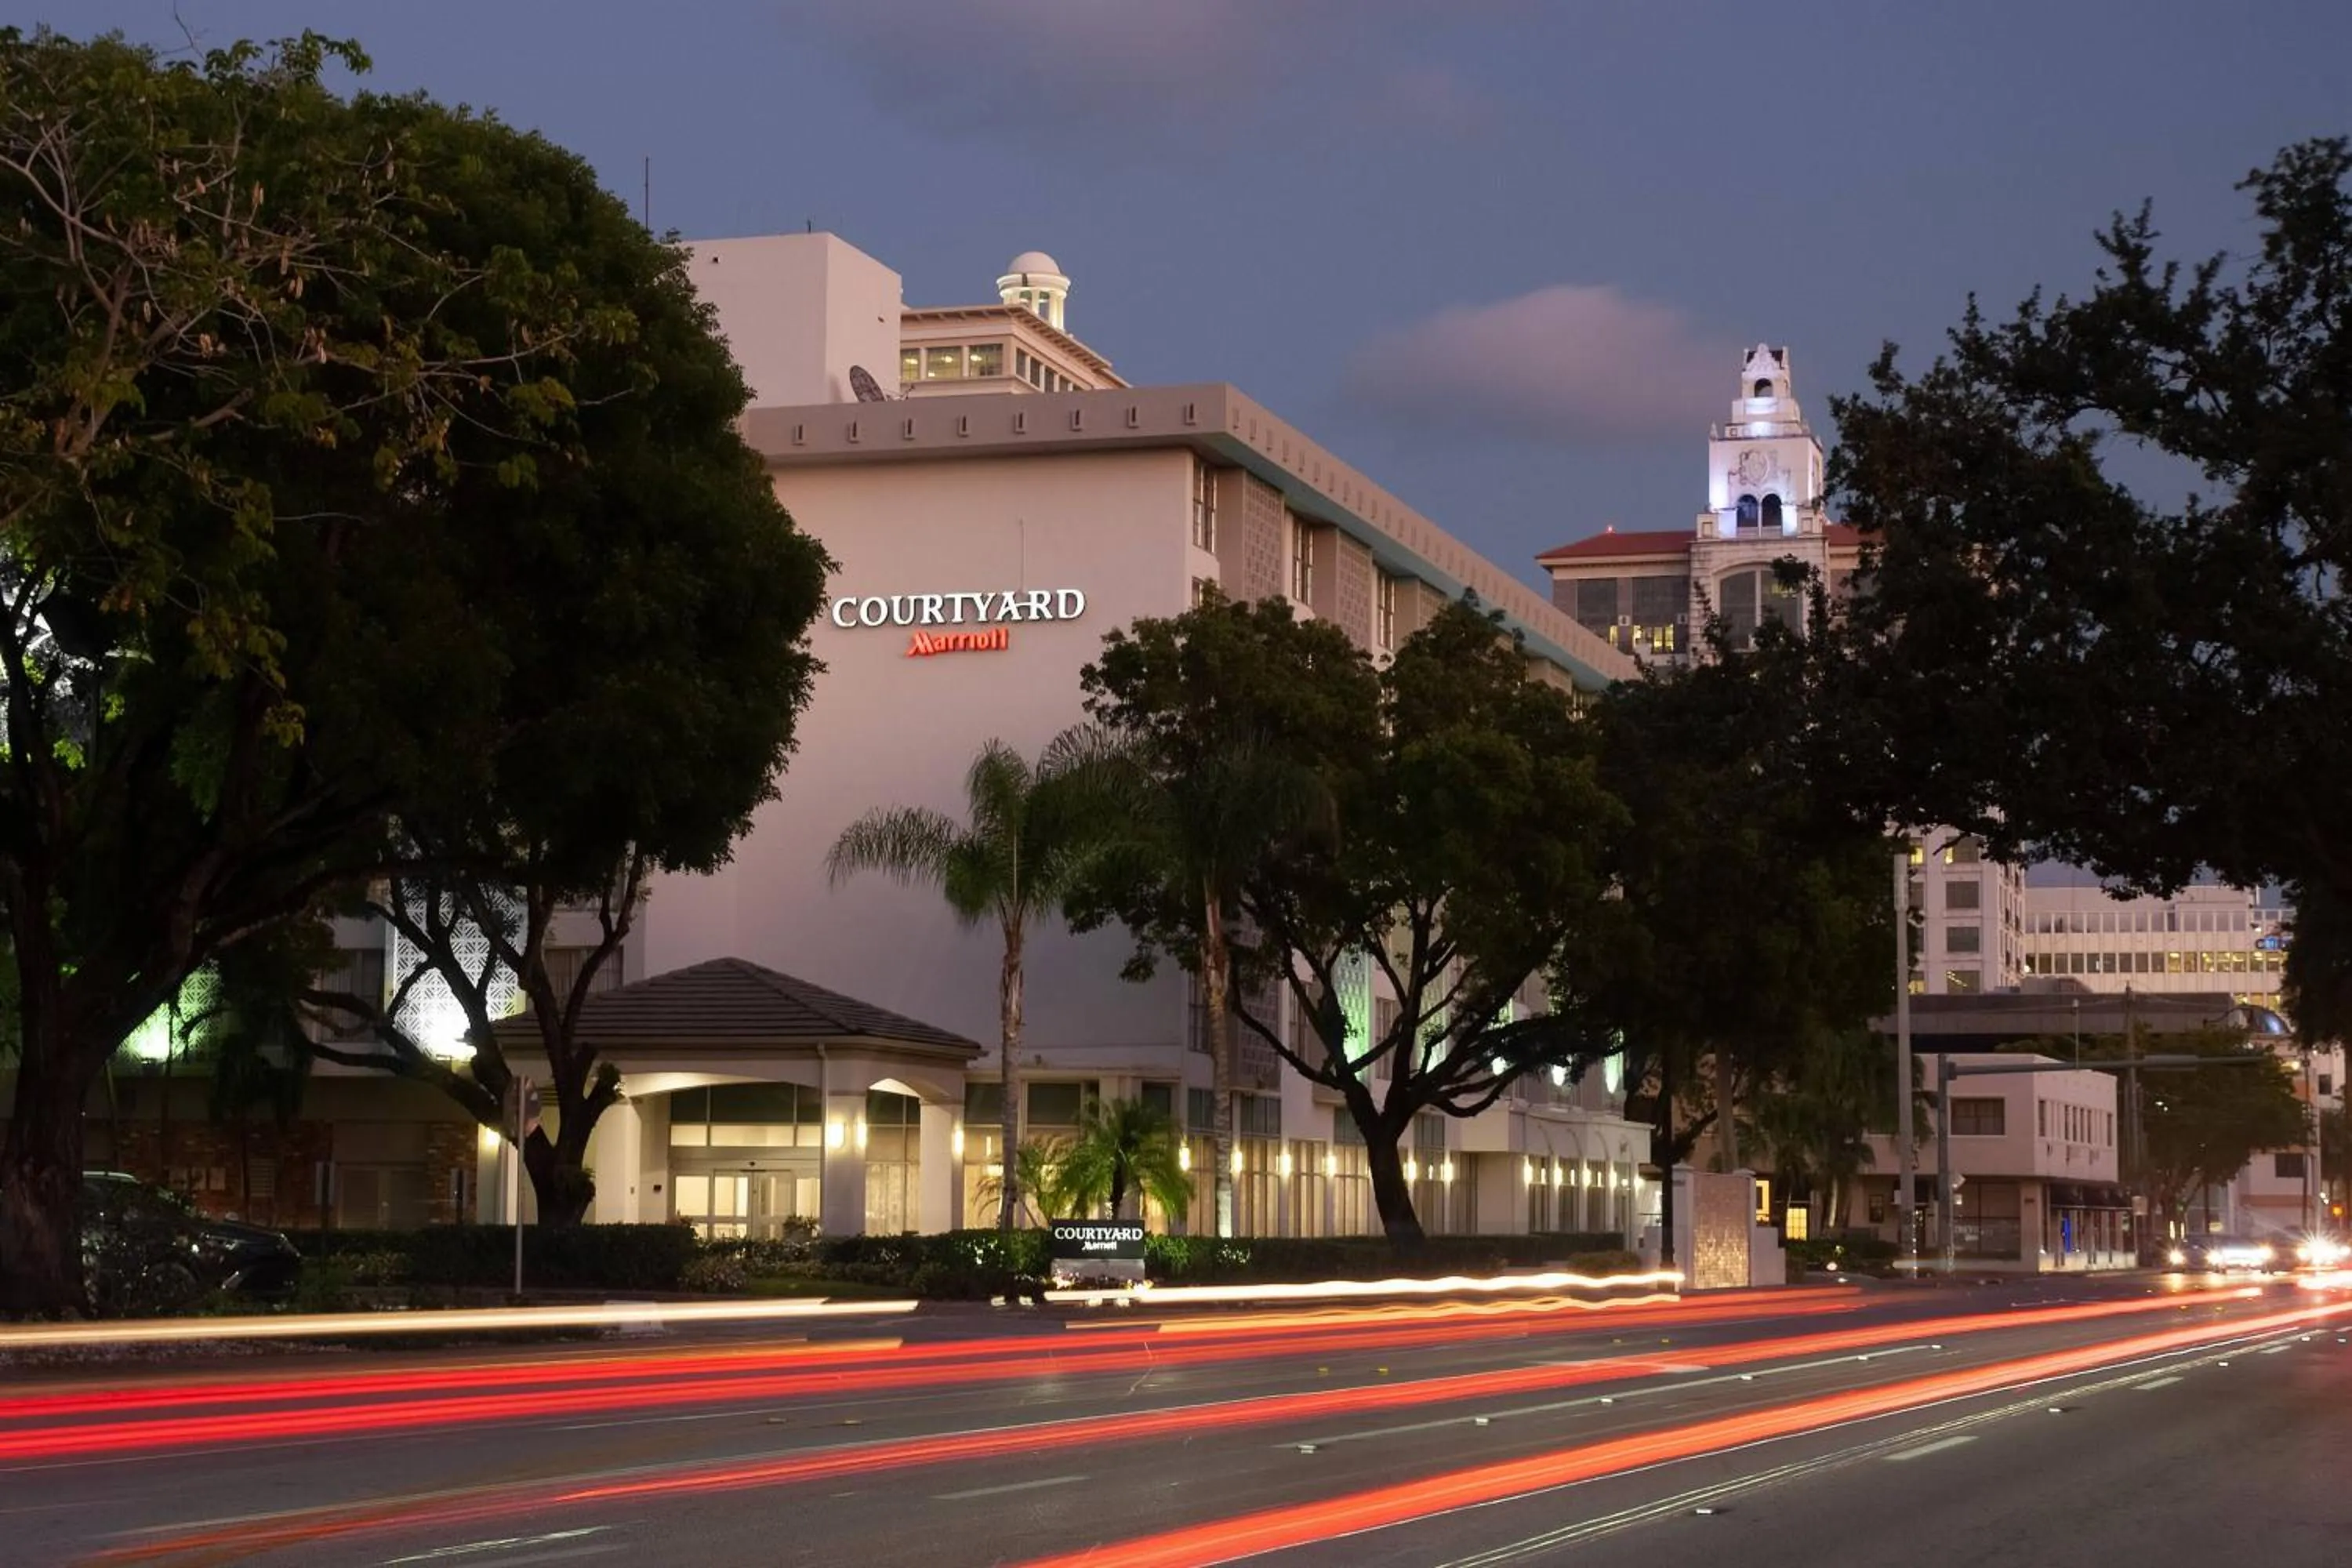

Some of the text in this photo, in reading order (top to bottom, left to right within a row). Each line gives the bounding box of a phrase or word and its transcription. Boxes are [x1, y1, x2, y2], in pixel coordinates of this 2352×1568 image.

[832, 589, 1086, 627] COURTYARD
[906, 628, 1009, 657] Marriott
[1054, 1227, 1144, 1240] COURTYARD
